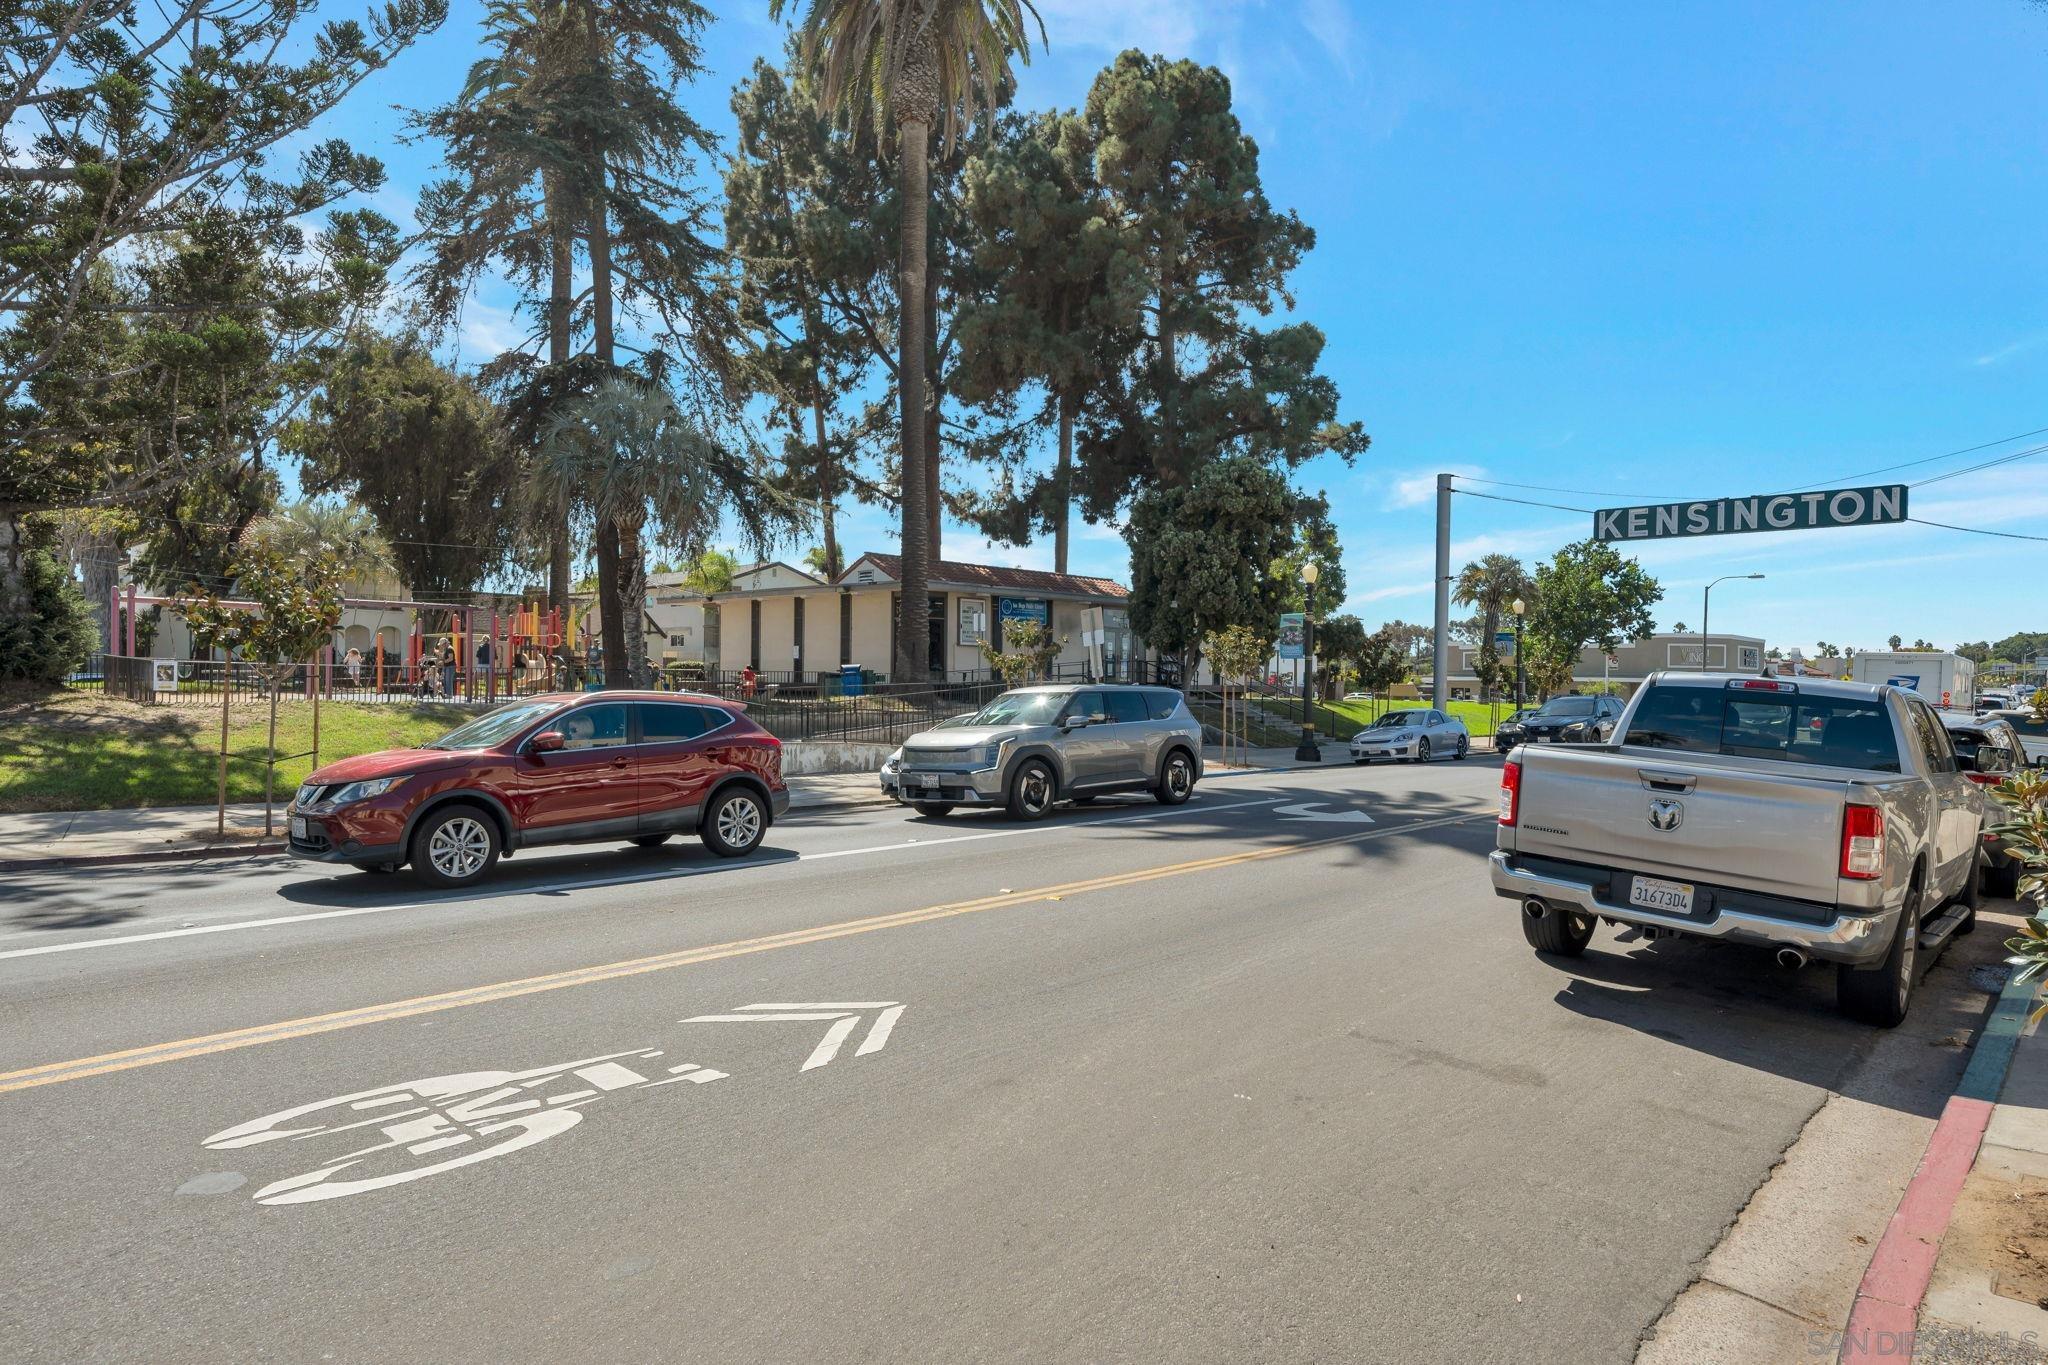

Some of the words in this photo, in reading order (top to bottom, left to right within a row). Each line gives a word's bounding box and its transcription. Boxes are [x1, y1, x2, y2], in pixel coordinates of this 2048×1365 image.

[1599, 487, 1901, 539] KENSINGTON
[1644, 880, 1679, 891] California
[1634, 887, 1688, 909] 31673D4
